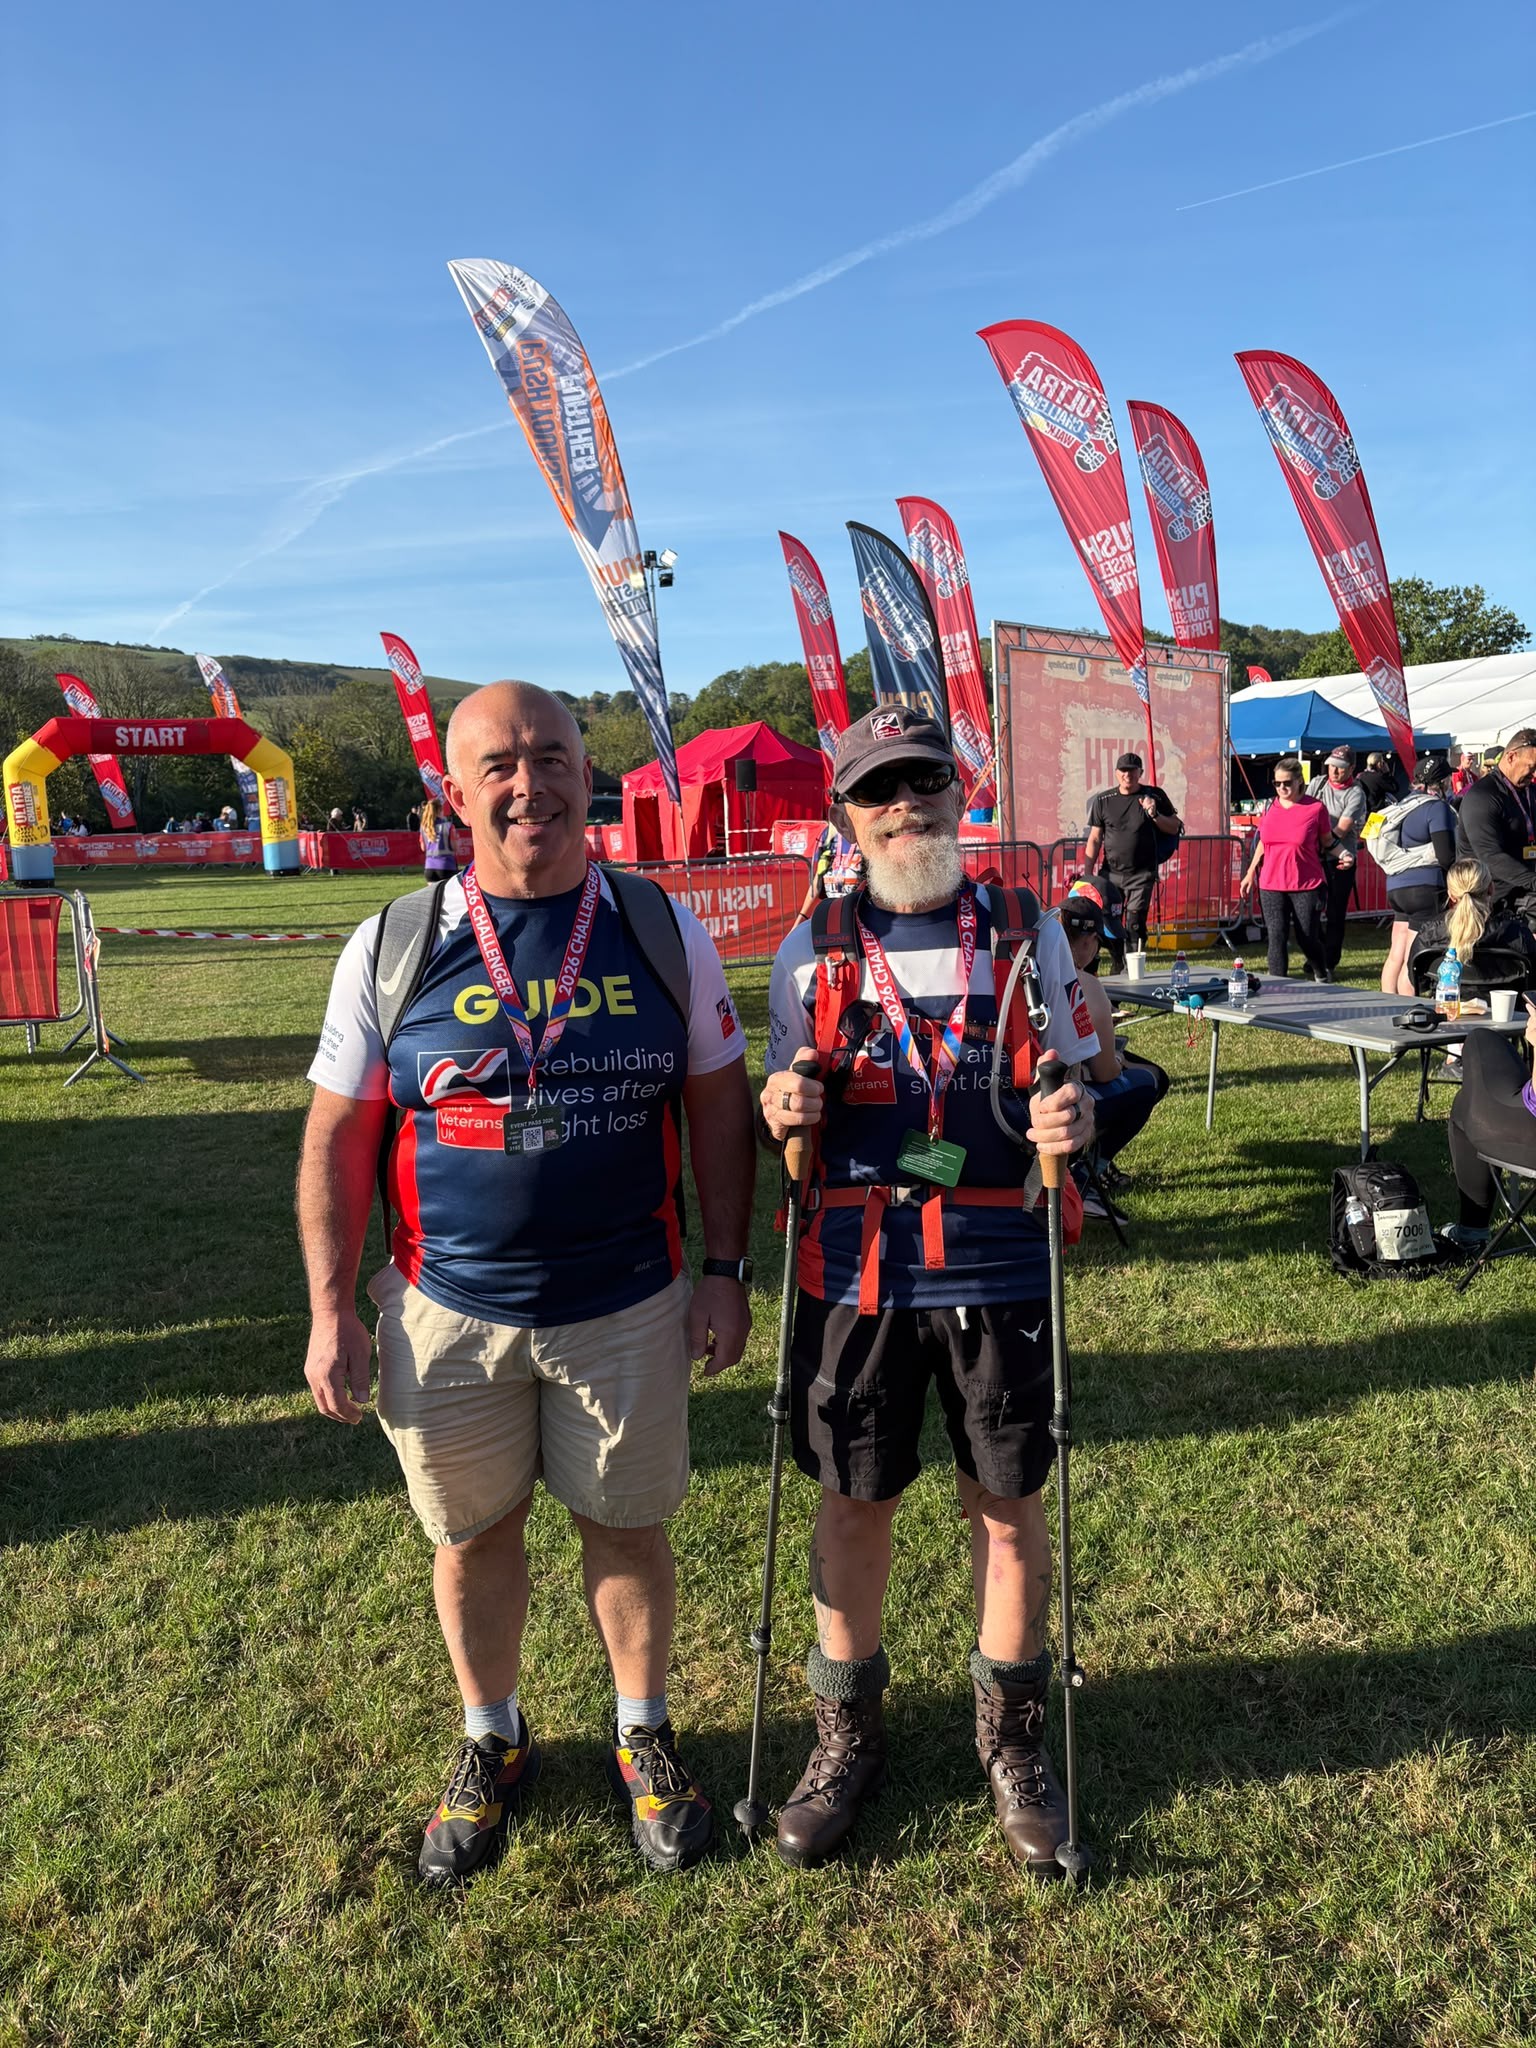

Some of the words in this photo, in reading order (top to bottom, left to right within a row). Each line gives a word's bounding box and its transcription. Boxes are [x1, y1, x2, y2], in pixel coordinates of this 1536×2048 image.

[115, 726, 187, 747] START
[11, 785, 28, 824] ULTRA
[265, 780, 281, 818] ULTRA
[465, 871, 480, 905] 2026
[960, 896, 975, 929] 2026
[558, 955, 581, 997] 2026
[570, 866, 599, 955] CHALLENGER
[472, 905, 514, 998] CHALLENGER
[879, 986, 905, 1027] 2026
[537, 1083, 595, 1106] ives
[603, 1080, 666, 1103] after
[440, 1112, 504, 1130] Veterans
[440, 1127, 457, 1142] UK
[510, 1121, 528, 1130] EVENT
[527, 1119, 542, 1127] PASS
[560, 1111, 600, 1145] ght
[608, 1109, 649, 1133] loss
